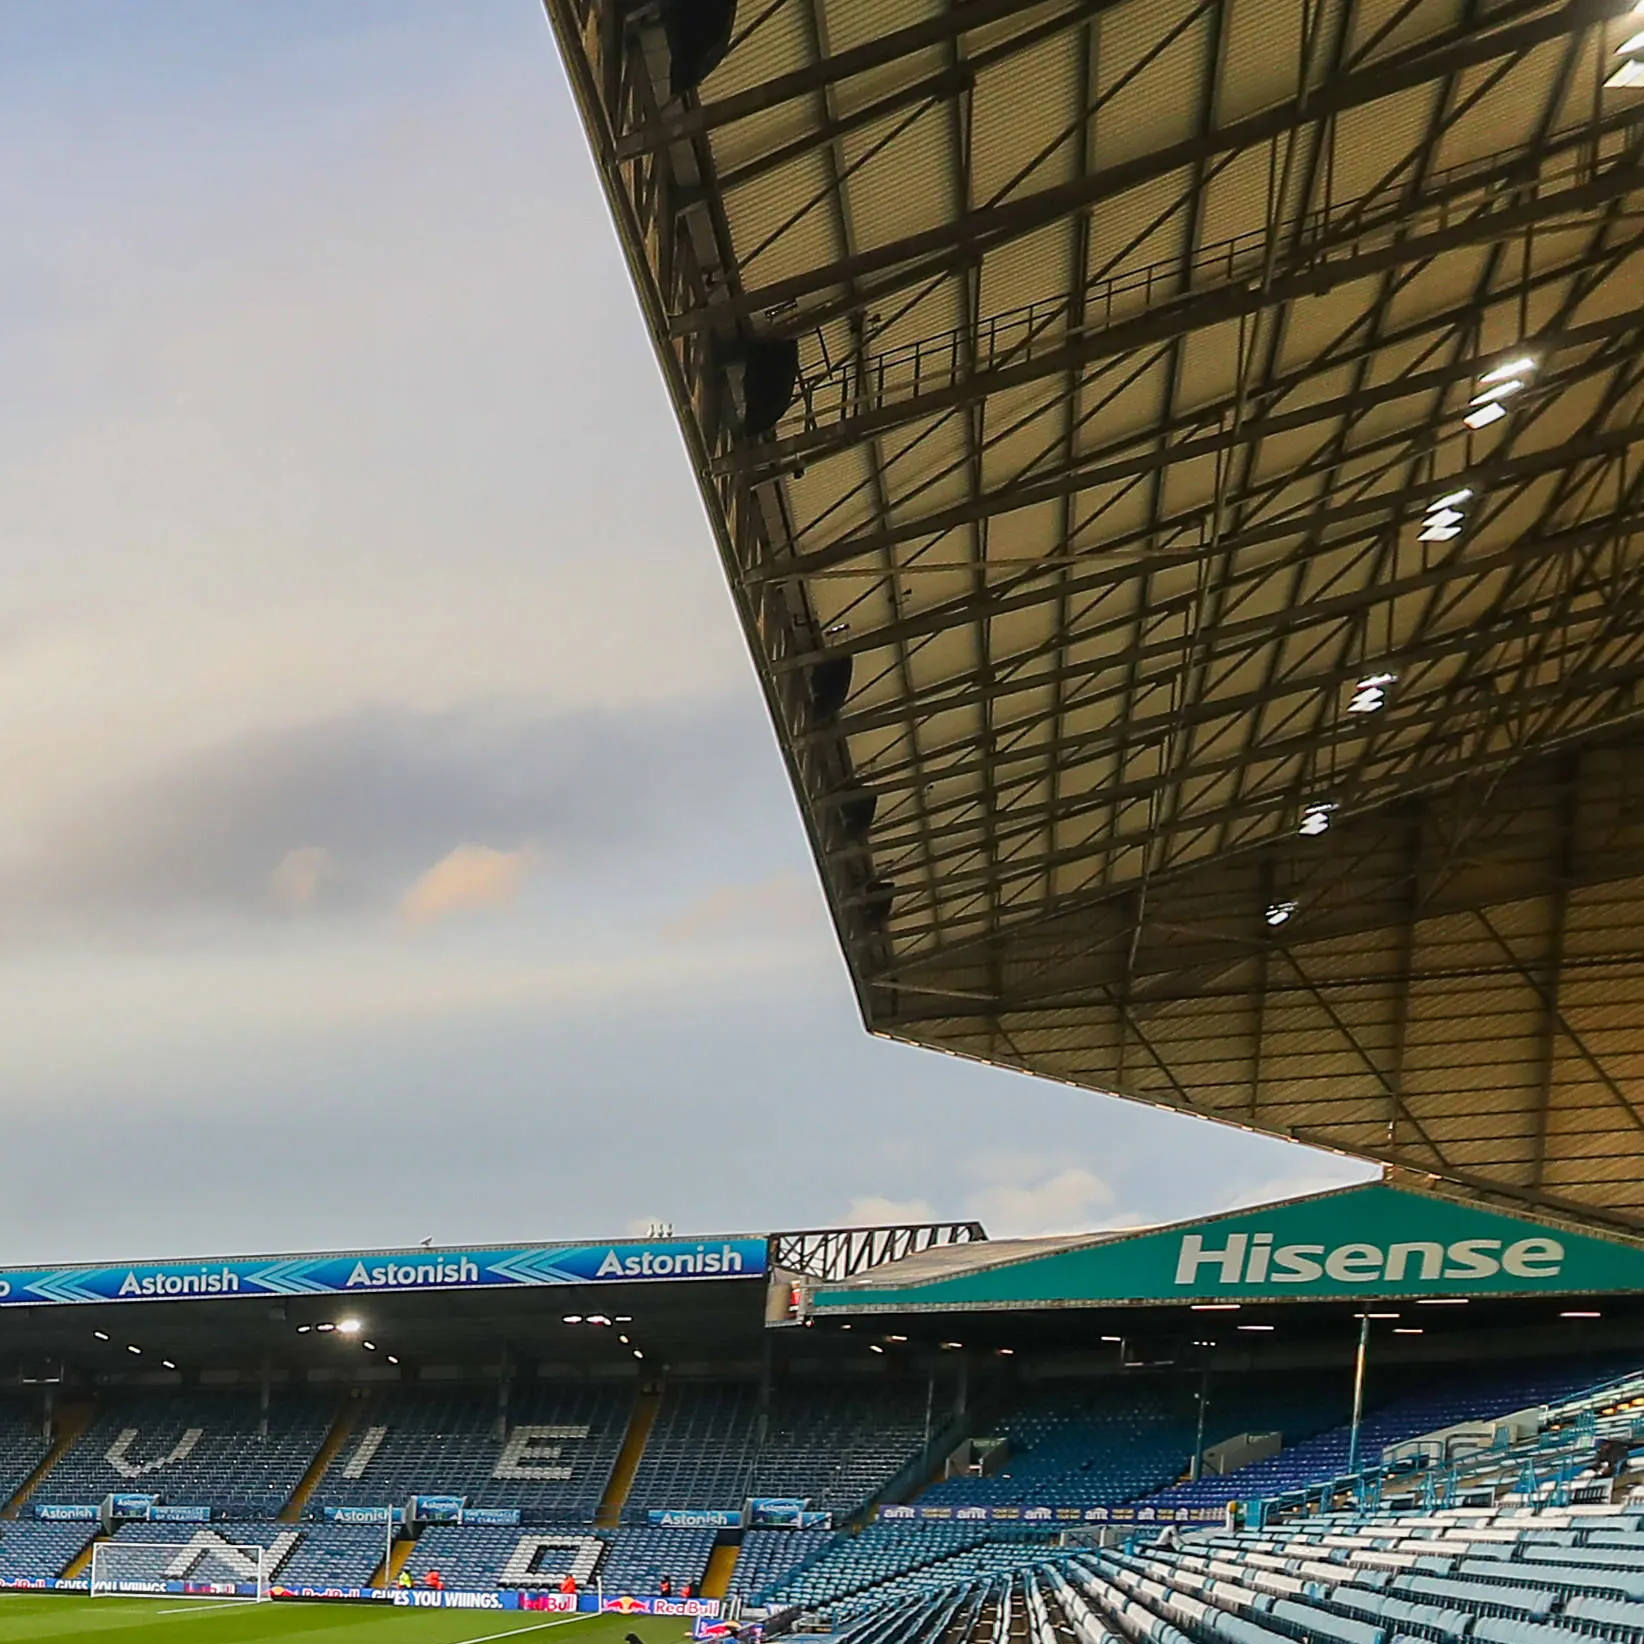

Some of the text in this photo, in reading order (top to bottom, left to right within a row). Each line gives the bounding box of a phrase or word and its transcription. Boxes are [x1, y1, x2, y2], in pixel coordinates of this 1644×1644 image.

[346, 1256, 479, 1288] Astonish
[596, 1244, 742, 1278] Astonish
[1174, 1232, 1565, 1286] Hisense
[118, 1267, 239, 1297] Astonish
[660, 1512, 728, 1526] Astonish
[371, 1589, 410, 1606] GIVES
[411, 1590, 442, 1607] YOU
[444, 1591, 504, 1609] WIIINGS.
